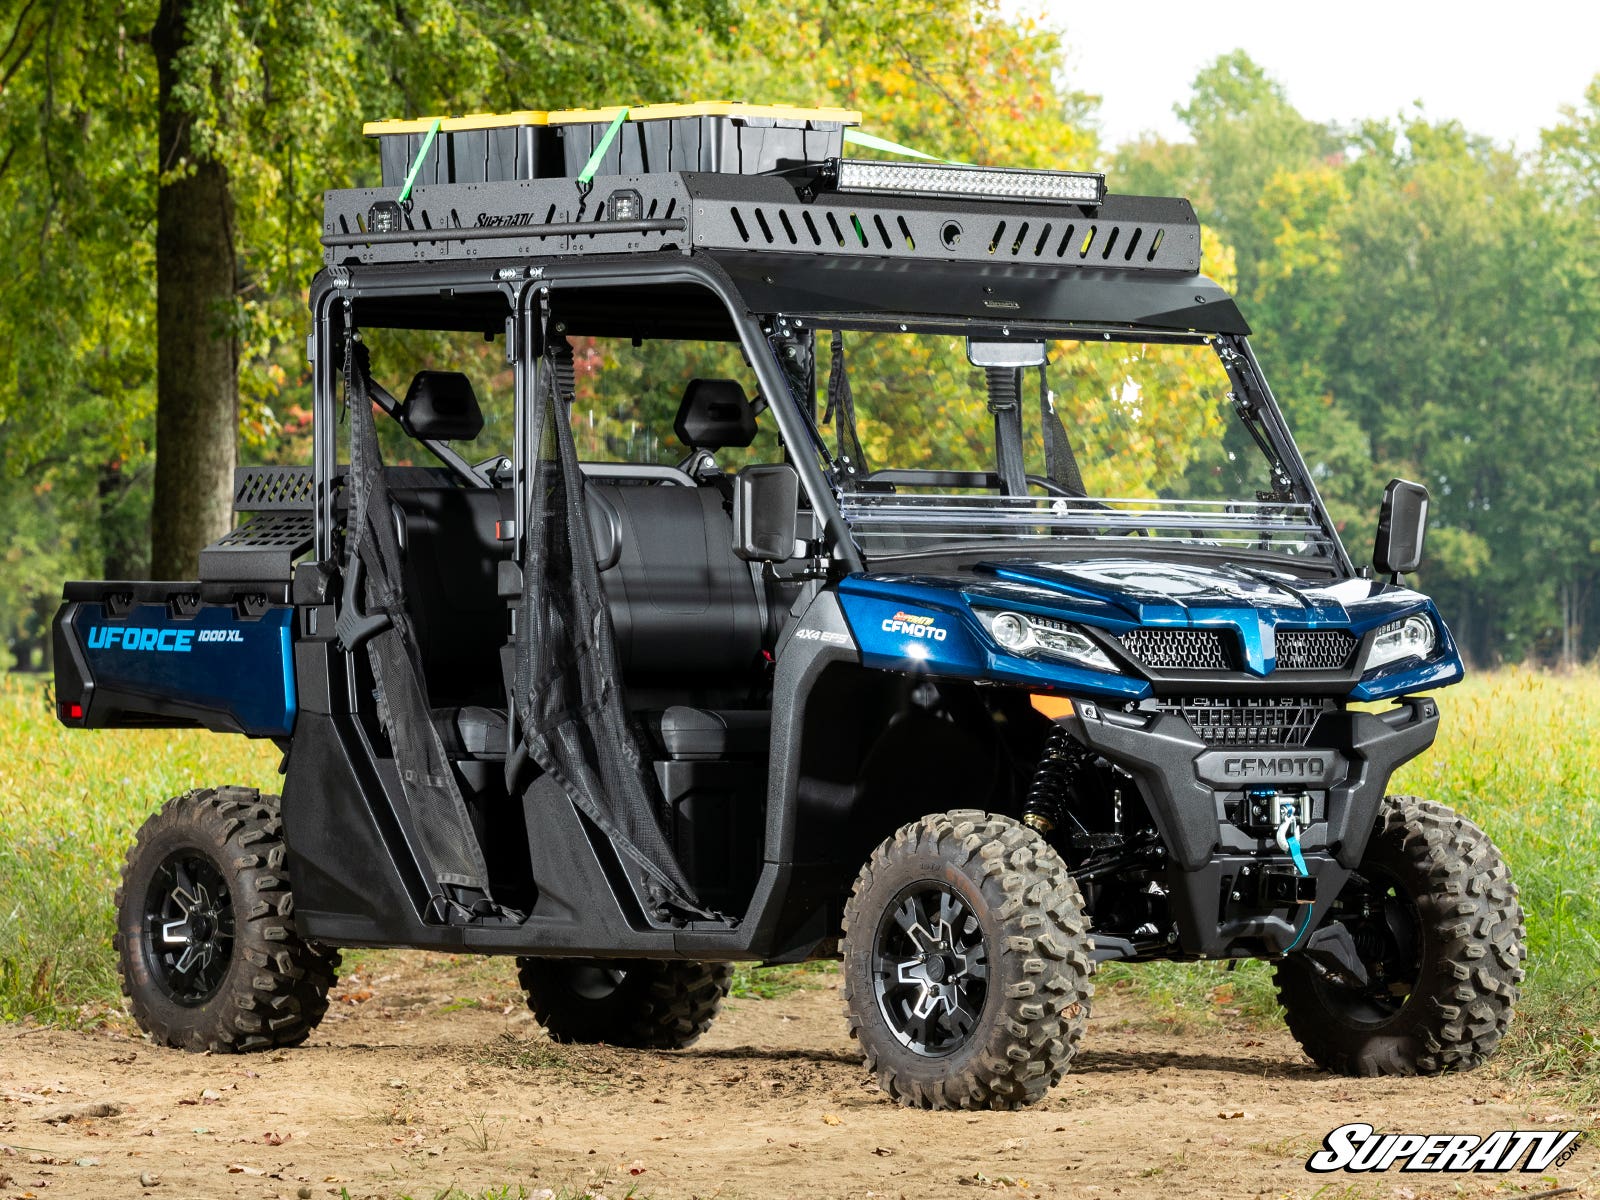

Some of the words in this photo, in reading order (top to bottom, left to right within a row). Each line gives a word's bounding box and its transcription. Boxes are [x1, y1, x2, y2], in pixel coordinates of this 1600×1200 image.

[88, 627, 195, 652] UFORCE
[198, 630, 226, 642] 1000
[226, 630, 244, 642] XL
[795, 629, 821, 640] 4X4
[820, 631, 849, 644] EPS
[881, 618, 947, 641] CFMOTO
[1224, 758, 1324, 776] CFMOTO
